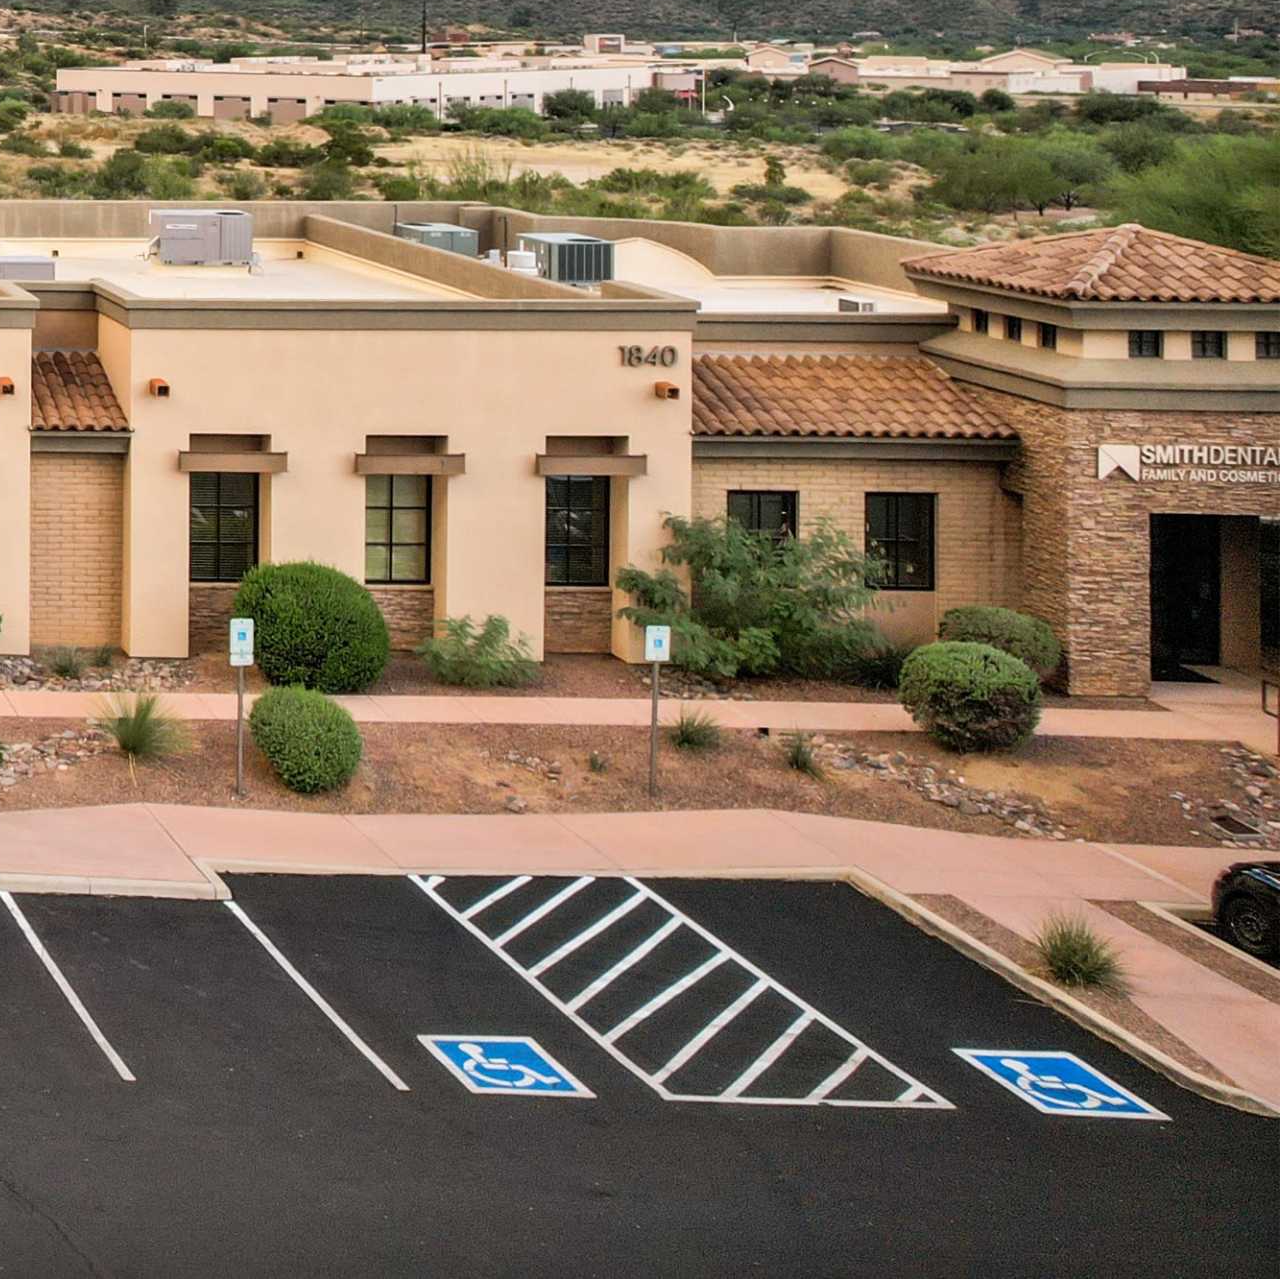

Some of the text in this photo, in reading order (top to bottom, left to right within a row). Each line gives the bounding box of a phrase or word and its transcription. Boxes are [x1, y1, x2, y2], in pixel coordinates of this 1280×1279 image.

[617, 345, 678, 368] 1840
[1141, 444, 1280, 466] SMITHDENTA
[1142, 469, 1280, 483] FAMILY AND COSMETI
